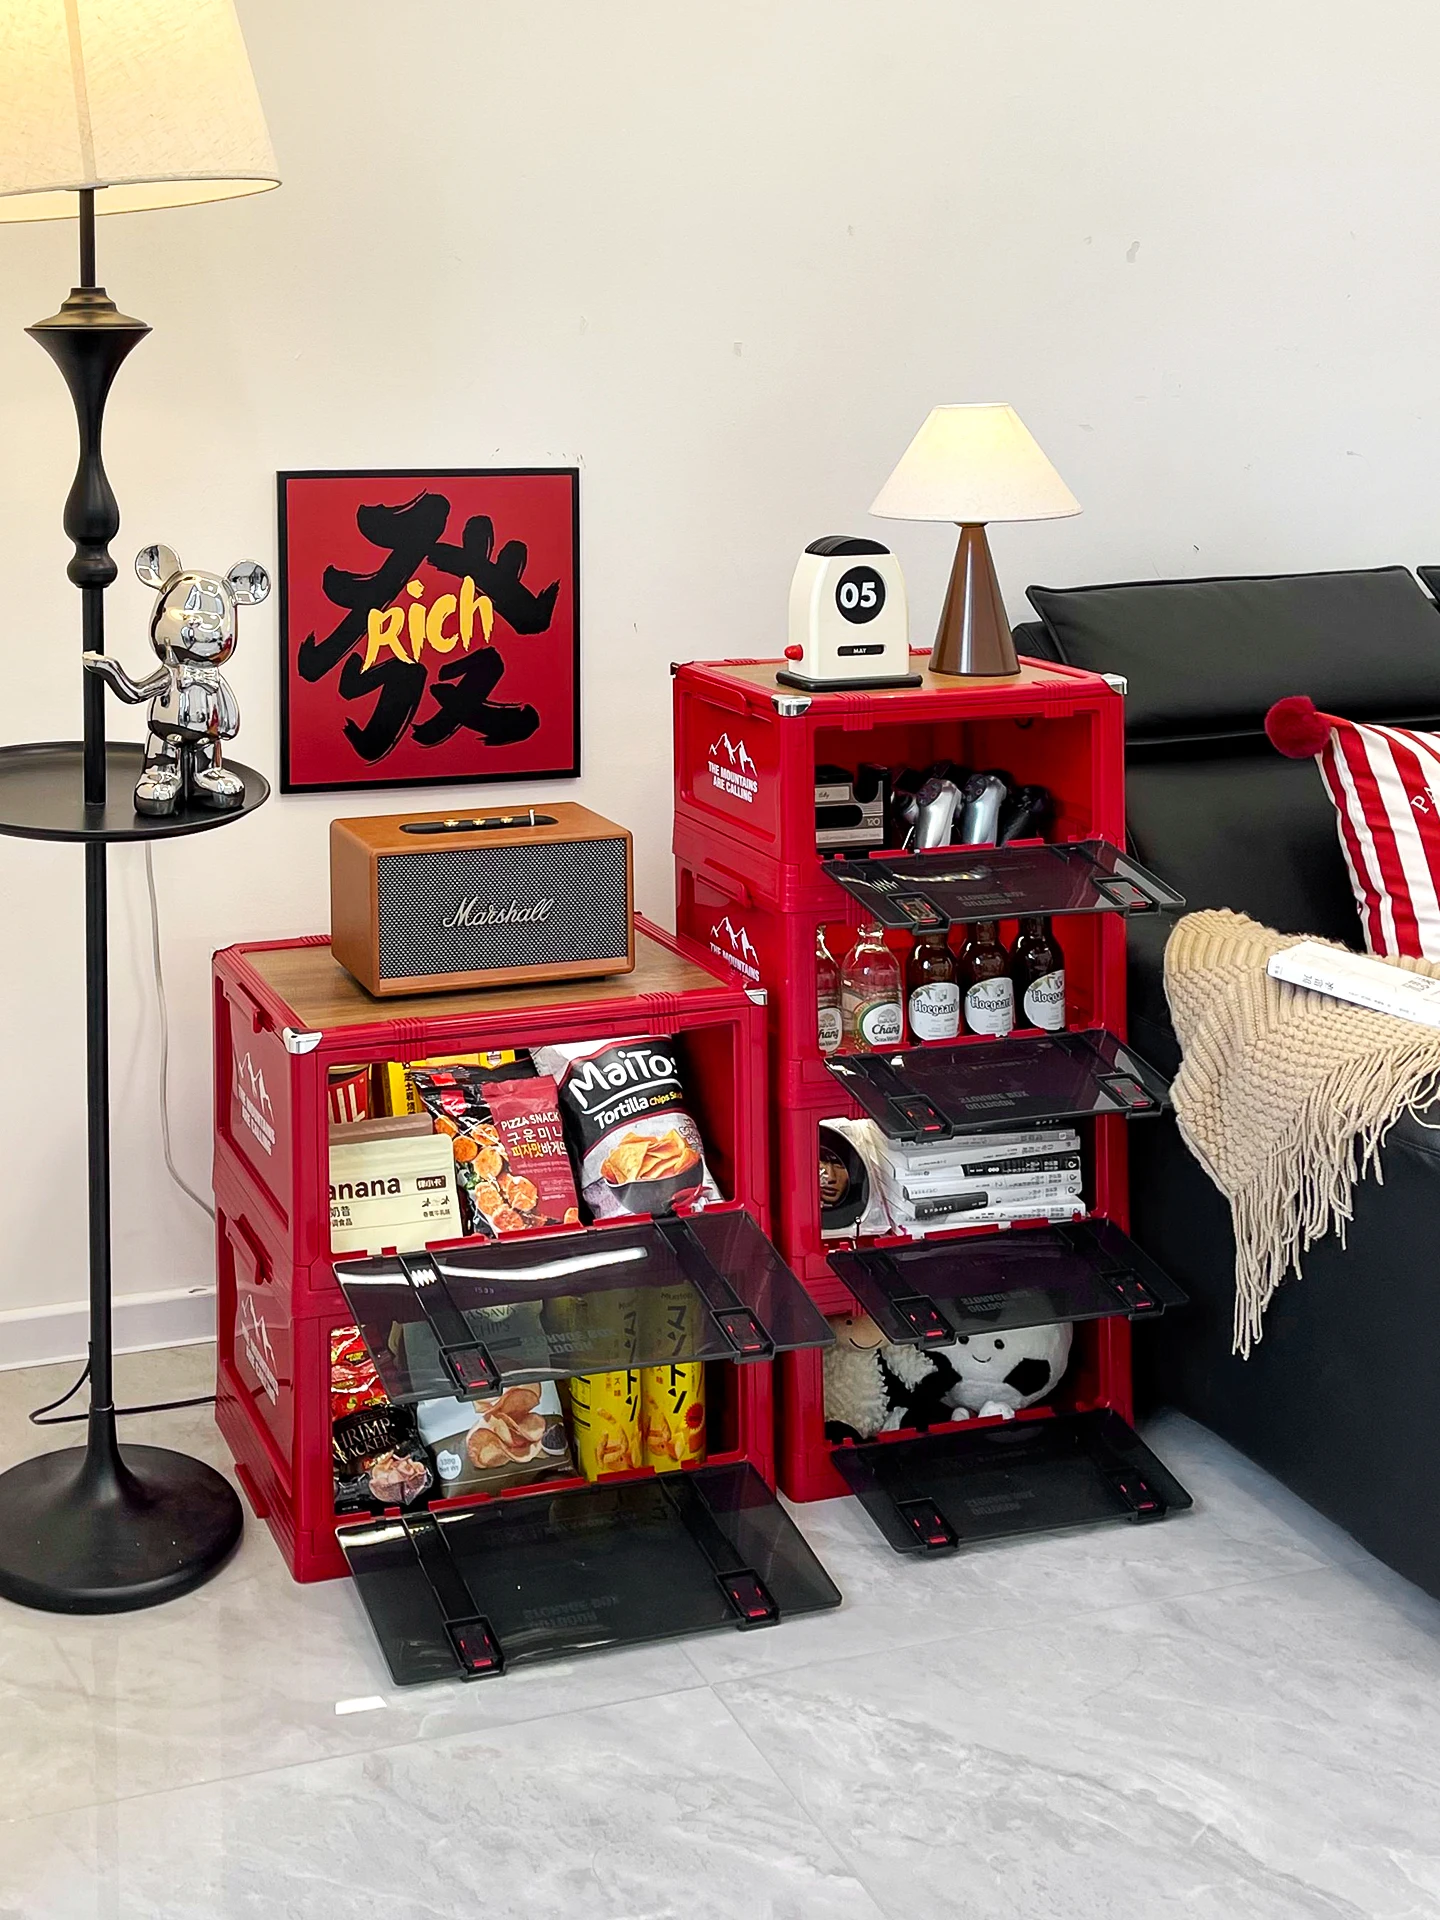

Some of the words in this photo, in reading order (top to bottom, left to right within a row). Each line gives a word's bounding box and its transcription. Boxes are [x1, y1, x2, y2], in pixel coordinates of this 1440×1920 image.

[840, 581, 877, 609] 05
[360, 575, 494, 674] Rich
[707, 760, 720, 776] THE
[720, 766, 758, 793] MOUNTAINS
[713, 775, 726, 791] ARE
[726, 781, 753, 803] CALLING
[442, 896, 554, 928] Marshall
[709, 941, 721, 956] THE
[722, 949, 760, 982] MOUNTAINS
[819, 1028, 839, 1040] hang
[872, 1024, 900, 1035] Chang
[501, 1116, 530, 1131] PIZZA
[529, 1111, 560, 1124] SNACK
[593, 1096, 649, 1130] Tortilla
[649, 1094, 670, 1106] Chips
[467, 1305, 517, 1320] ASSAVA
